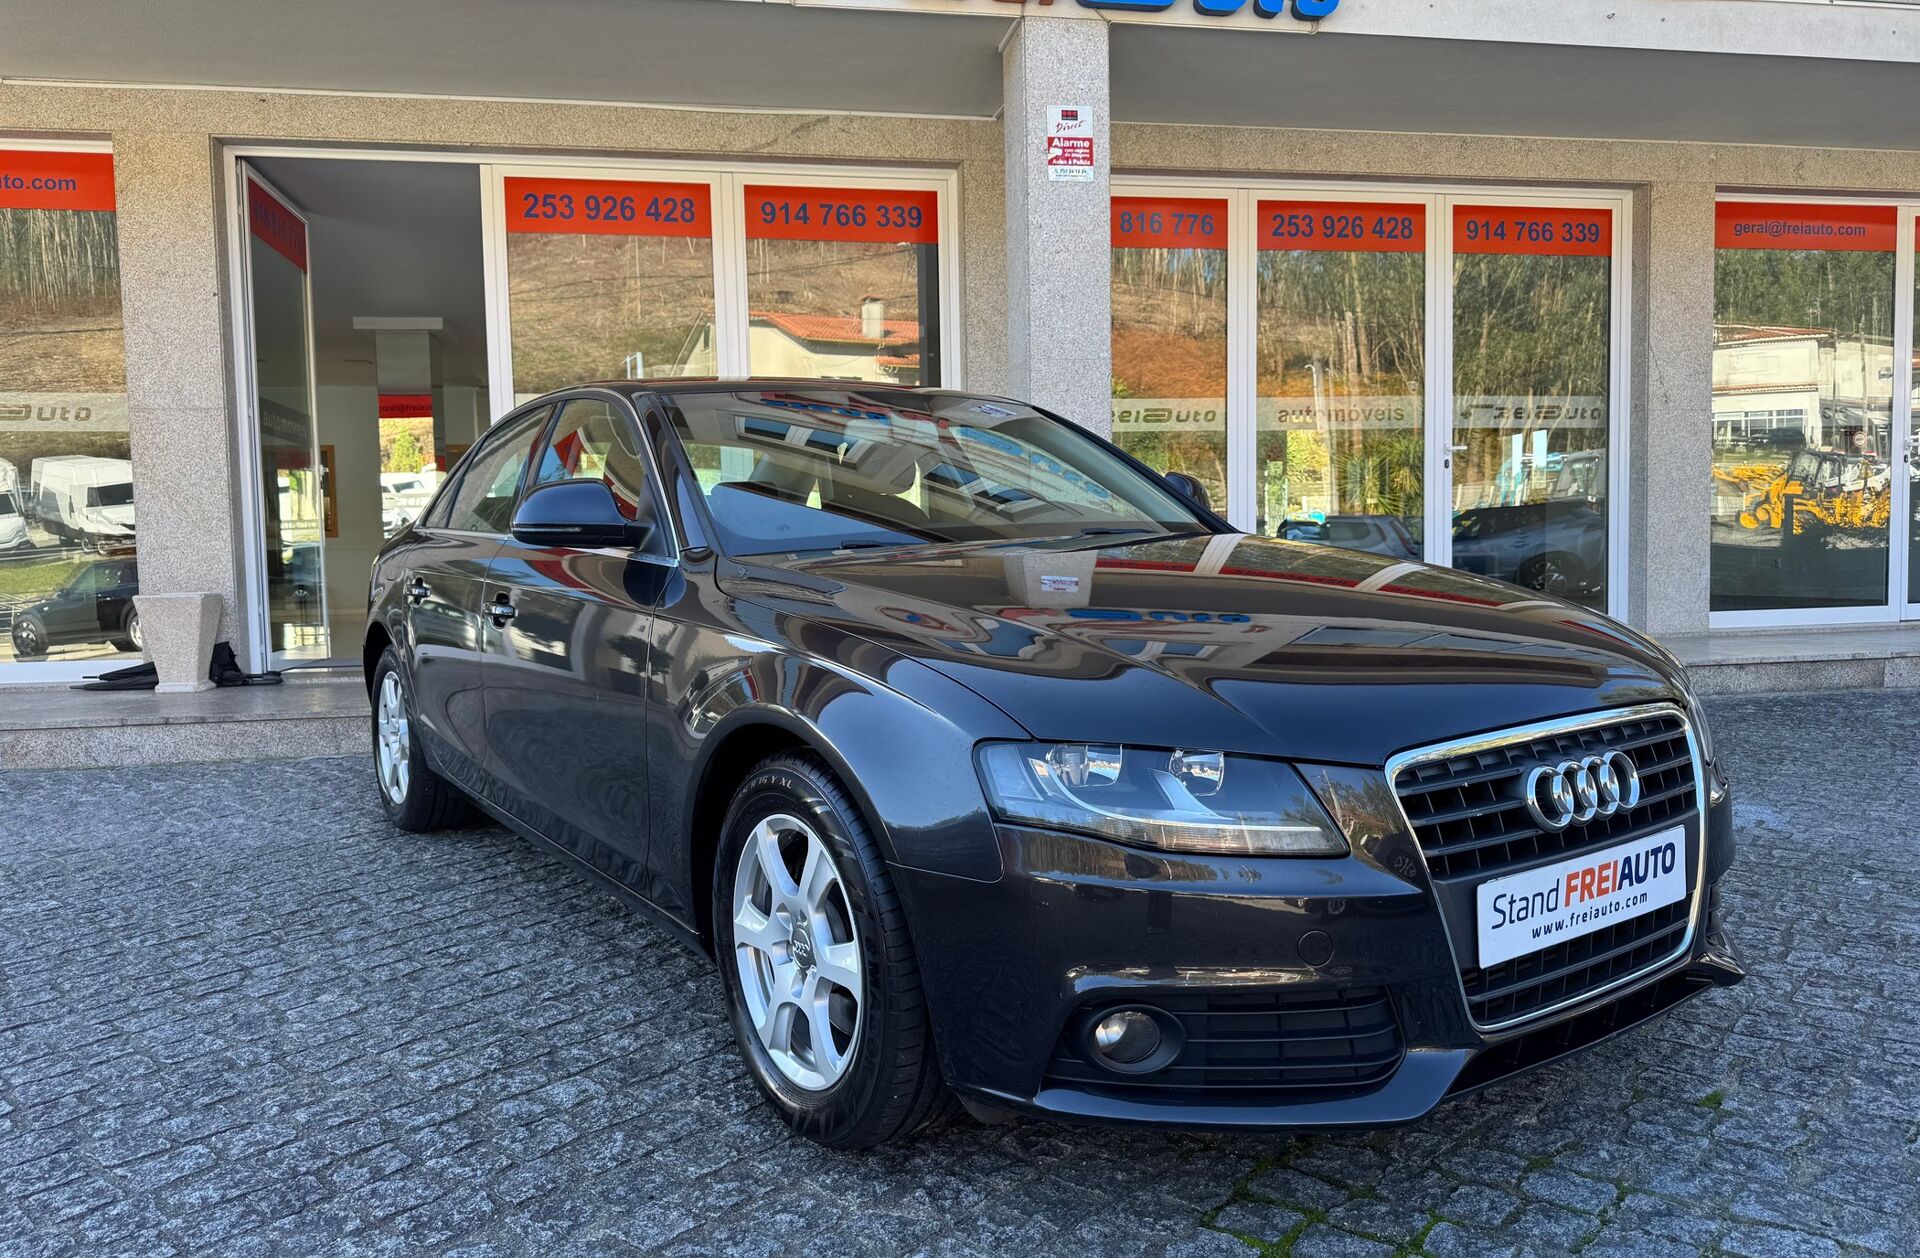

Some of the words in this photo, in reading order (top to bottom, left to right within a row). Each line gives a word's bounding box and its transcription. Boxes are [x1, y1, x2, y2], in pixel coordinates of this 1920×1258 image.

[1056, 120, 1086, 133] Direct
[1052, 138, 1090, 148] Alarme
[0, 174, 77, 191] to.com
[523, 193, 575, 219] 253
[584, 195, 636, 222] 926
[645, 197, 696, 224] 428
[760, 201, 810, 225] 914
[819, 203, 867, 228] 766
[876, 205, 923, 229] 339
[1119, 211, 1163, 234] 816
[1171, 212, 1215, 236] 776
[1271, 213, 1315, 238] 253
[1322, 215, 1364, 239] 926
[1371, 217, 1414, 240] 428
[1466, 219, 1506, 241] 914
[1514, 221, 1554, 243] 766
[1561, 223, 1600, 244] 339
[1734, 221, 1866, 237] geral@freiauto.com
[1491, 878, 1560, 930] Stand
[1564, 841, 1676, 908] FREIAUTO
[1531, 891, 1648, 939] www.freiauto.com
